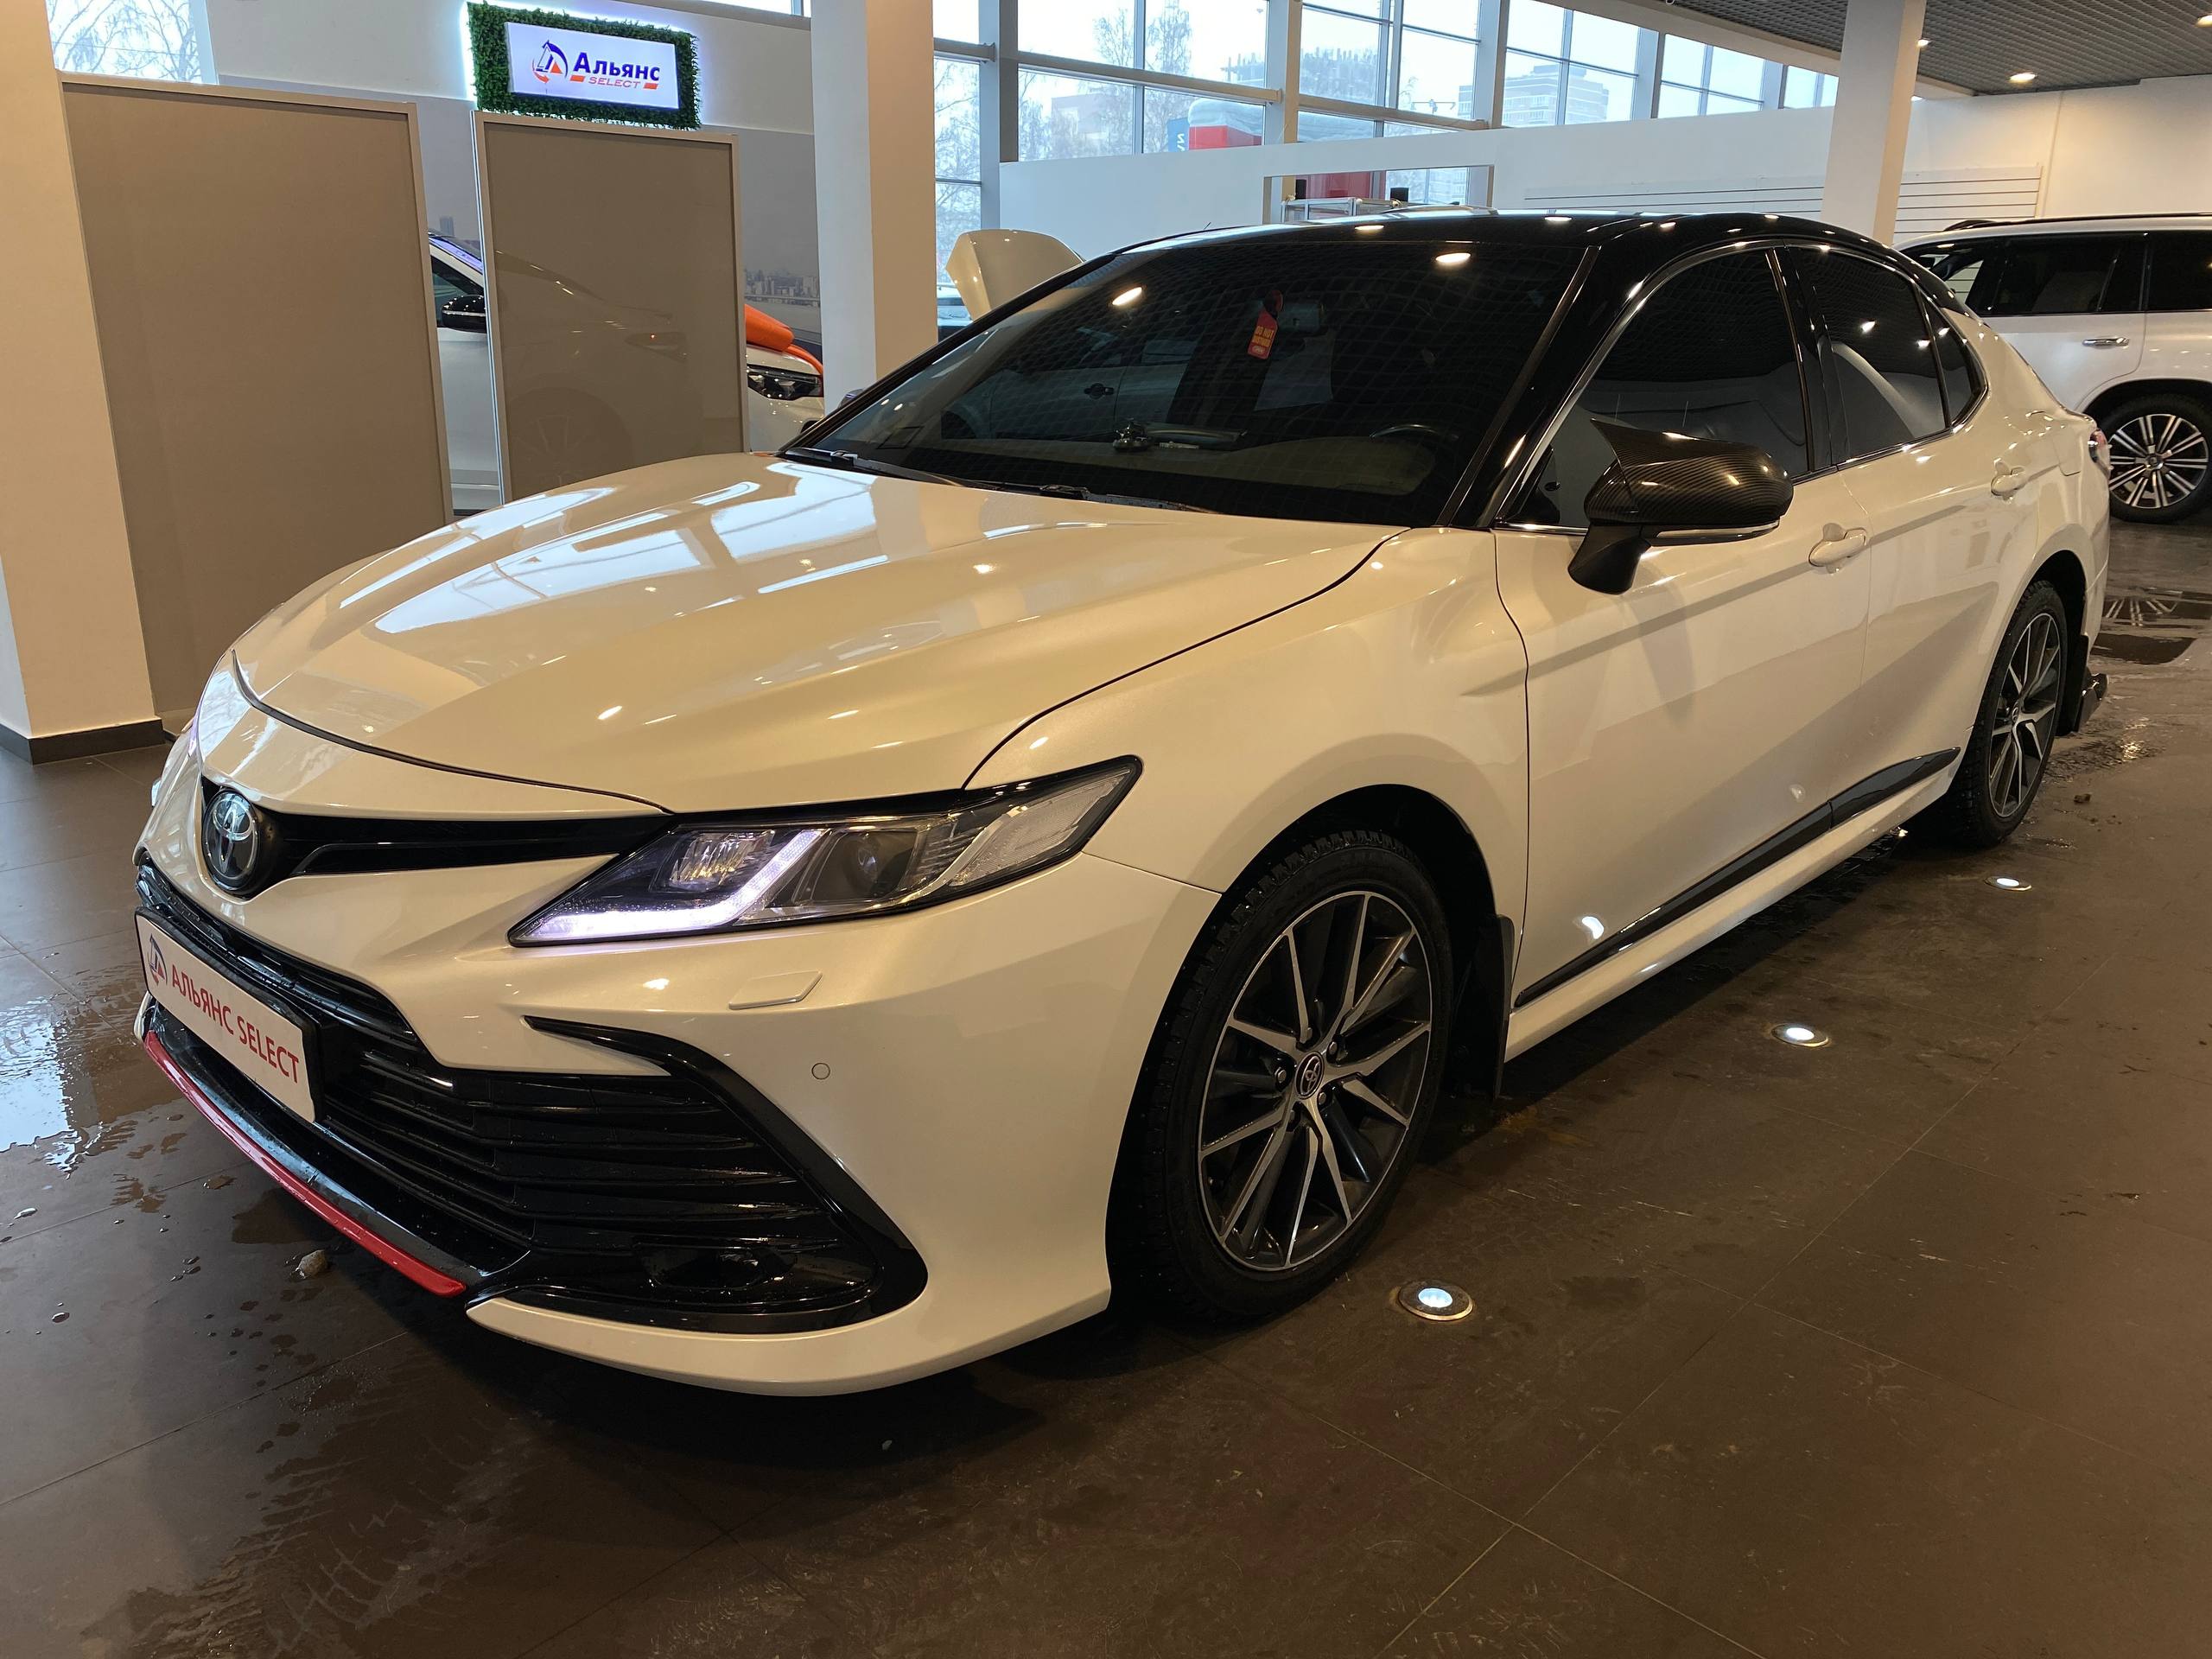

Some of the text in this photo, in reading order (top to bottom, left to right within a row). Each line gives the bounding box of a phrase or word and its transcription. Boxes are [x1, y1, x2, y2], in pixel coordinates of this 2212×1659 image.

[574, 52, 660, 81] Альянс
[588, 77, 641, 88] SELECT
[172, 964, 299, 1084] АЛЬЯНС SELECT
